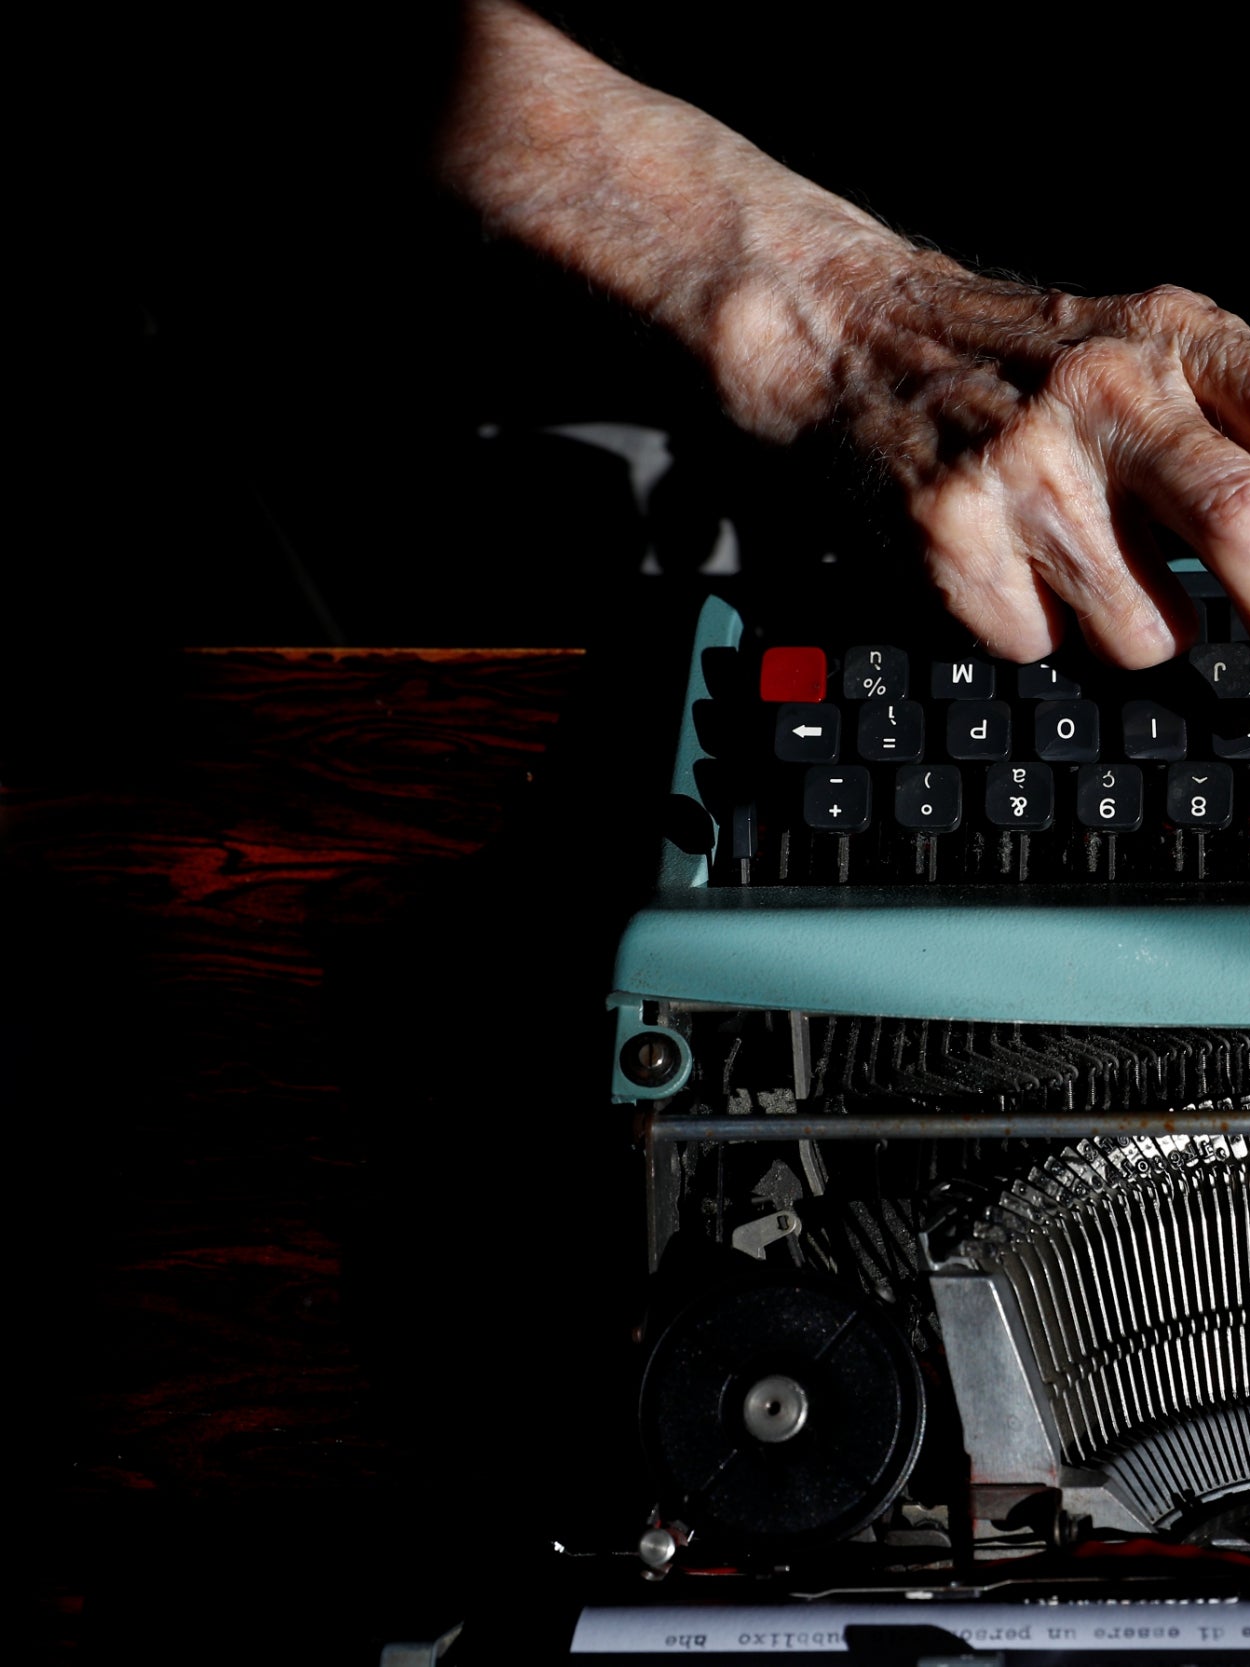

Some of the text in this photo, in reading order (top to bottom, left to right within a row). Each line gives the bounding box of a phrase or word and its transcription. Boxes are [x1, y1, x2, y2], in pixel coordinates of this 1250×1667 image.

[869, 650, 882, 671] ù
[951, 663, 974, 684] M
[1213, 661, 1227, 682] J
[862, 676, 887, 698] %
[969, 718, 988, 740] P
[882, 737, 896, 749] =
[1011, 768, 1027, 790] à
[1102, 769, 1116, 789] ç
[828, 803, 843, 818] +
[1008, 796, 1028, 818] &
[1098, 797, 1116, 818] 9
[1190, 795, 1207, 817] 8
[1047, 1627, 1076, 1642] un
[1198, 1626, 1224, 1643] di
